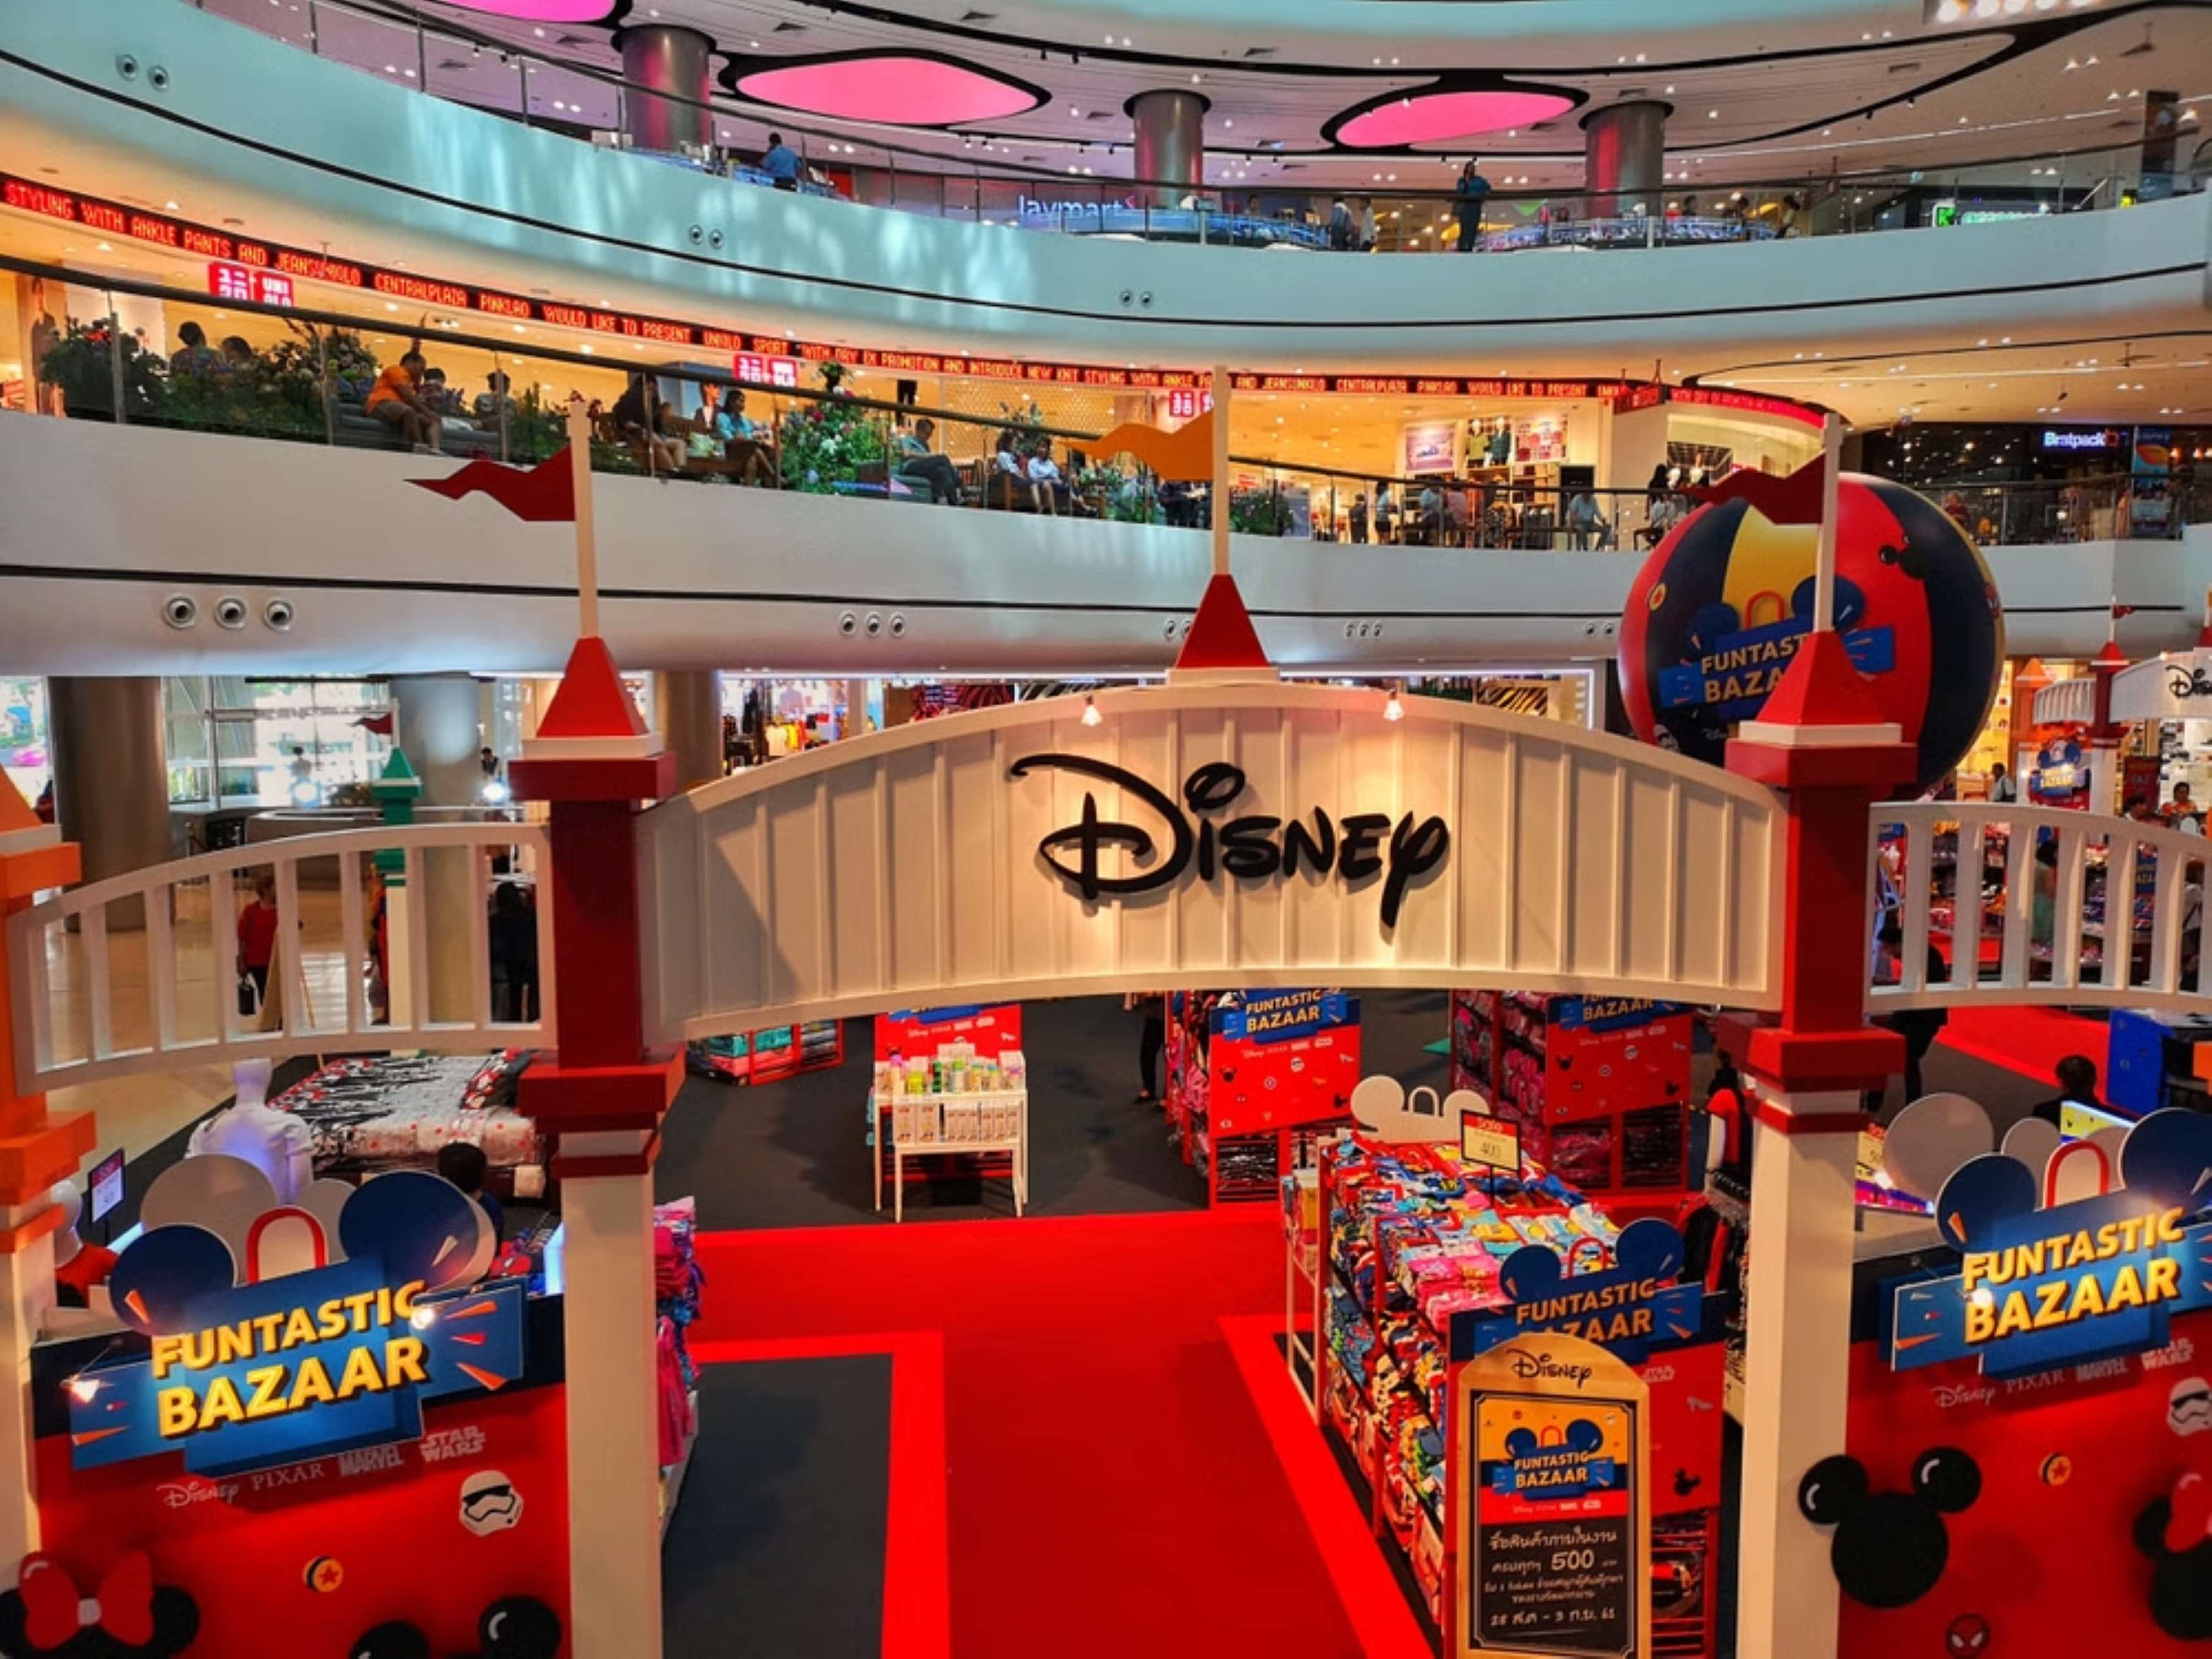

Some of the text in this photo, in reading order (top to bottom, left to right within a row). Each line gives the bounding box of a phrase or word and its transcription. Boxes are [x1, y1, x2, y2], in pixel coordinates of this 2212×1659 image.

[5, 181, 75, 220] STYLING
[80, 201, 124, 233] WITH
[131, 216, 177, 246] ANKLE
[184, 230, 231, 259] PANTS
[238, 244, 267, 267] AND
[374, 272, 468, 308] CENTRALPLAZA
[542, 303, 586, 329] WOULD
[622, 318, 638, 336] TO
[642, 321, 691, 344] PRESENT
[1701, 634, 1808, 675] FUNTAST
[1704, 665, 1784, 703] BAZA
[1246, 989, 1322, 1015] FUNTASTIC
[1246, 1004, 1321, 1033] BAZAAR
[1583, 998, 1654, 1022] BAZAAR
[1962, 1206, 2185, 1291] FUNTASTIC
[1517, 1277, 1657, 1325] FUNTASTIC
[1964, 1256, 2182, 1345] BAZAAR
[150, 1279, 427, 1379] FUNTASTIC
[156, 1336, 430, 1438] BAZAAR
[2005, 1369, 2065, 1394] PIXAR
[252, 1462, 324, 1492] PIXAR
[337, 1444, 404, 1478] MARVEL
[1514, 1450, 1589, 1471] FUNTASTIC
[1516, 1467, 1588, 1489] BAZAAR
[1550, 1548, 1595, 1571] 500
